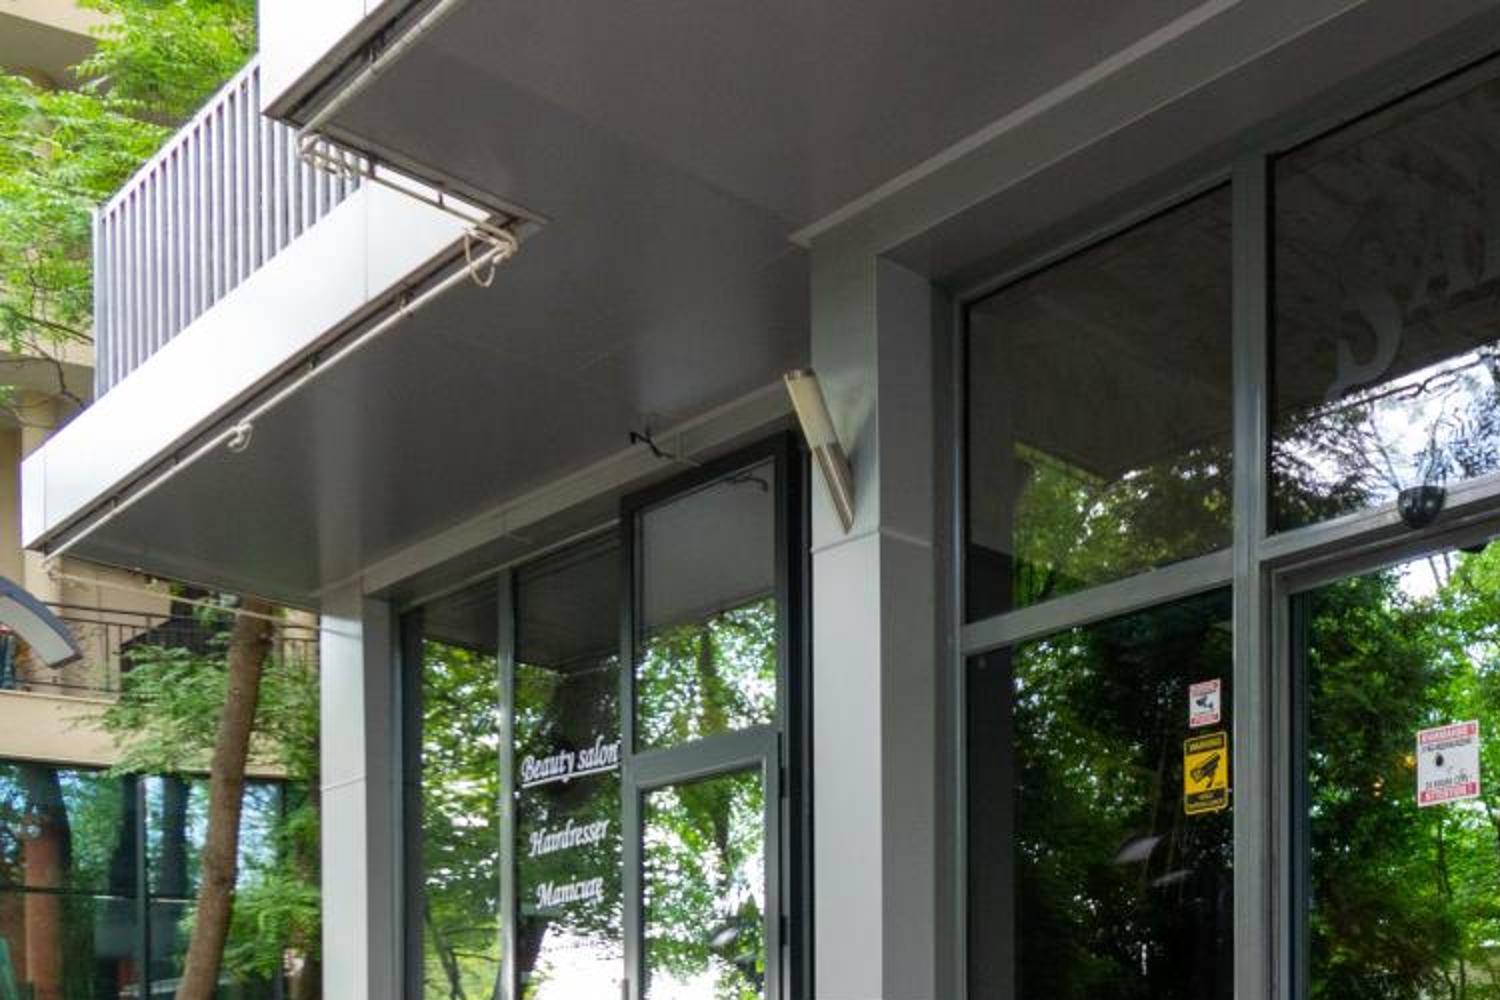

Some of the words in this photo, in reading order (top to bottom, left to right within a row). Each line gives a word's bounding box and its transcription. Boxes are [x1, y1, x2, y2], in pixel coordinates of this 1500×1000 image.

[521, 749, 574, 784] Beauty
[577, 736, 619, 769] salon
[536, 874, 605, 909] Manicure
